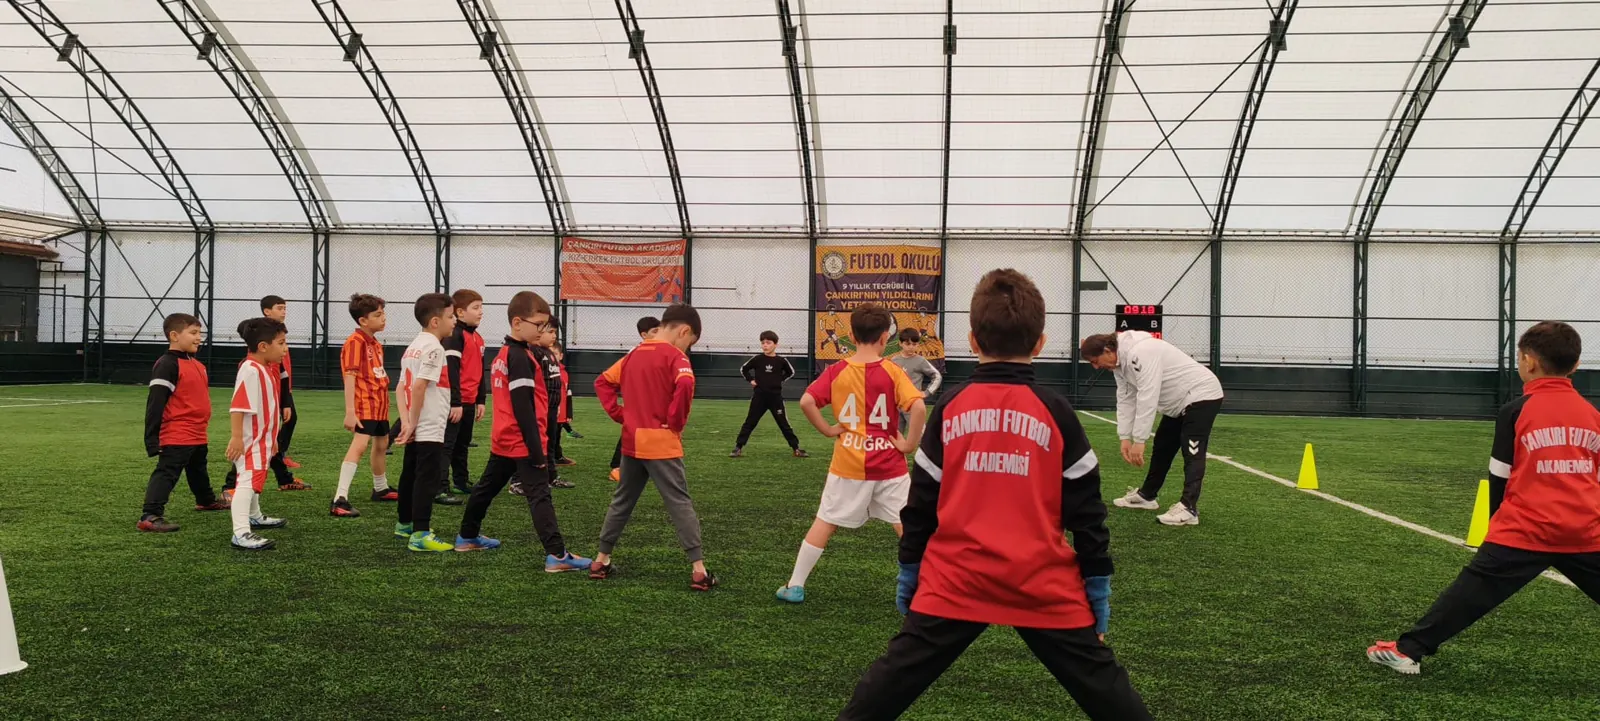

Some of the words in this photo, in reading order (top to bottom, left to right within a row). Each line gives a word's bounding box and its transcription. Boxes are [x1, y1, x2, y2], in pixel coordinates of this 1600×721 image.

[603, 243, 635, 251] FUTBOL
[610, 255, 640, 265] FUTBOL
[850, 253, 897, 270] FUTBOL
[901, 253, 940, 272] OKULU
[872, 282, 904, 290] TECRÜBE
[905, 282, 915, 290] İLE
[881, 291, 934, 301] YILDIZLARINI
[1120, 319, 1128, 328] A
[1150, 320, 1158, 328] B
[942, 408, 1002, 446] ÇANKIRI
[1002, 409, 1052, 452] FUTBOL
[842, 431, 895, 452] BUĞRA
[963, 449, 1030, 477] AKADEMİSİ
